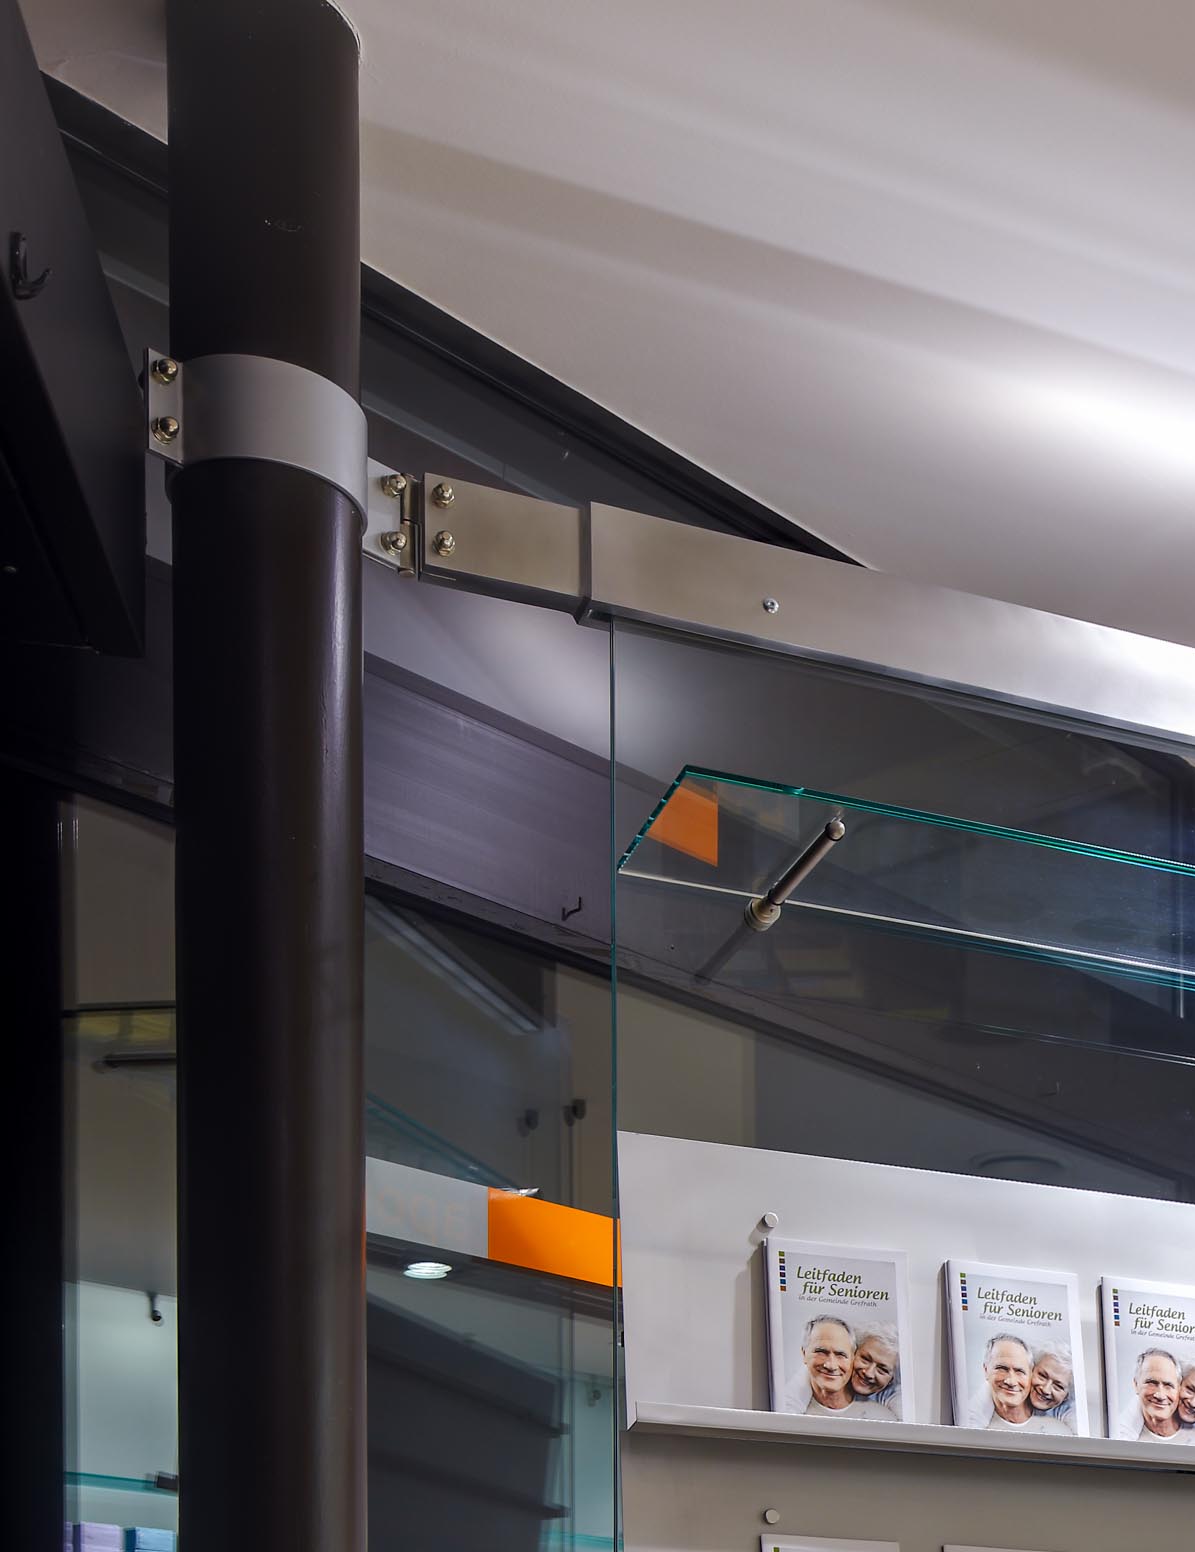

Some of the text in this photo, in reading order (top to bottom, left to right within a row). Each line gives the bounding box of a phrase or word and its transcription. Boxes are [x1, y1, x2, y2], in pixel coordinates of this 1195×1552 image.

[796, 1265, 862, 1285] Leitfaden
[802, 1281, 889, 1301] für Senioren
[977, 1286, 1038, 1306] Leitfaden
[983, 1301, 1062, 1322] für Senioren
[1128, 1302, 1186, 1321] Leitfaden
[1134, 1316, 1154, 1330] für
